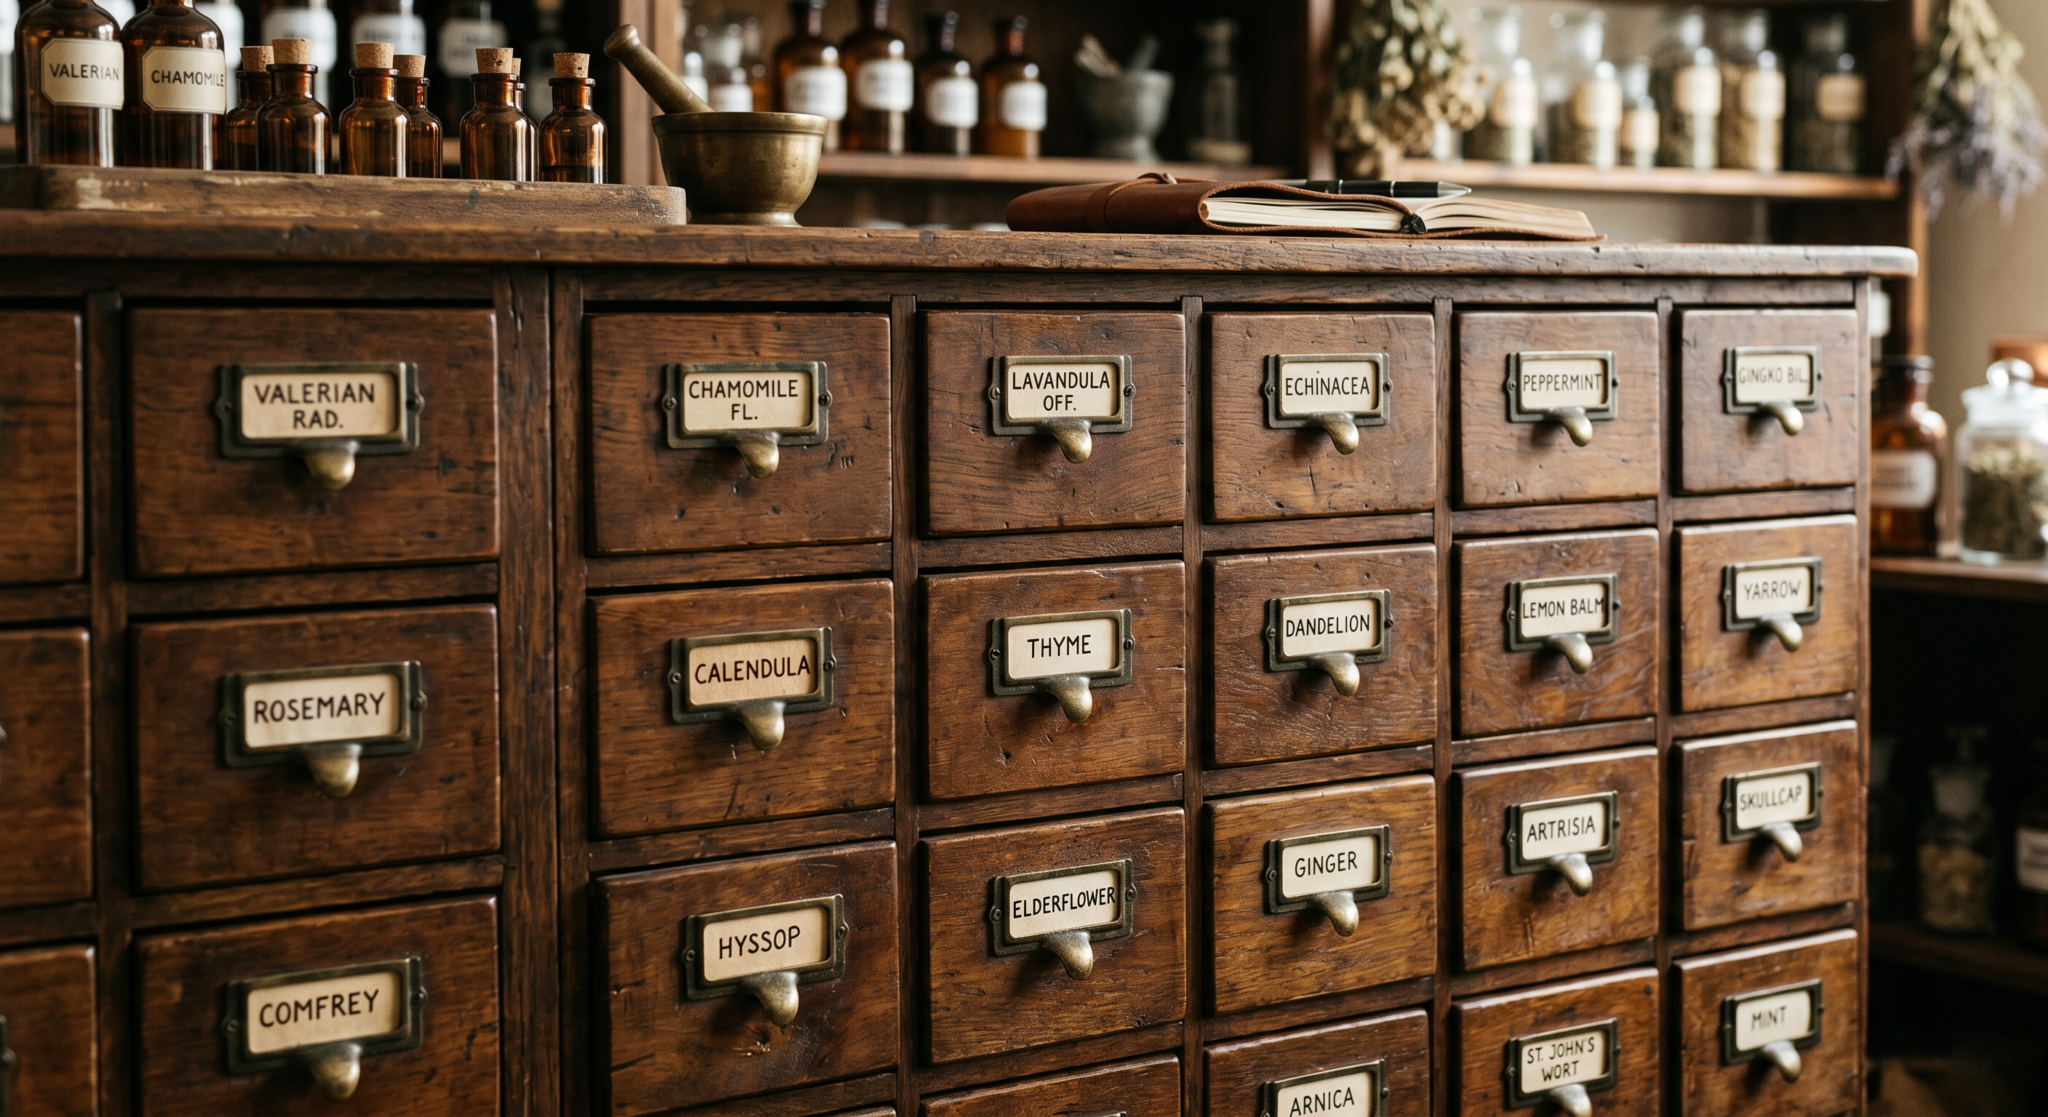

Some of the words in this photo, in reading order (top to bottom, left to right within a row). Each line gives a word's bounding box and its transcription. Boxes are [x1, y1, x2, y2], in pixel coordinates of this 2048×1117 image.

[50, 64, 119, 81] VALERIAN
[151, 70, 224, 87] CHAMOMILE
[1012, 371, 1110, 389] LAVANDULA
[1285, 376, 1370, 396] ECHINACEA
[1523, 373, 1602, 391] PEPPERMINT
[1739, 368, 1783, 383] GINGKO
[255, 383, 375, 404] VALERIAN
[689, 380, 799, 399] CHAMOMILE
[731, 404, 758, 420] FL.
[1044, 395, 1076, 411] OFF.
[294, 410, 343, 428] RAD.
[1744, 580, 1801, 599] YARROW
[1522, 601, 1564, 619] LEMON
[1571, 598, 1605, 615] BALM
[1285, 614, 1370, 637] DANDELION
[1027, 635, 1092, 658] THYME
[694, 655, 811, 684] CALENDULA
[254, 693, 386, 723] ROSEMARY
[1739, 785, 1802, 811] SKULLCAP
[1527, 816, 1595, 842] ARTRISIA
[1294, 851, 1358, 877] GINGER
[1012, 887, 1116, 919] ELDERFLOWER
[719, 926, 800, 959] HYSSOP
[259, 989, 379, 1027] COMFREY
[1751, 1006, 1787, 1028] MINT
[1527, 1047, 1544, 1063] ST.
[1549, 1036, 1595, 1061] JOHN'S
[1541, 1060, 1578, 1082] WORT
[1289, 1087, 1354, 1117] ARNICA
